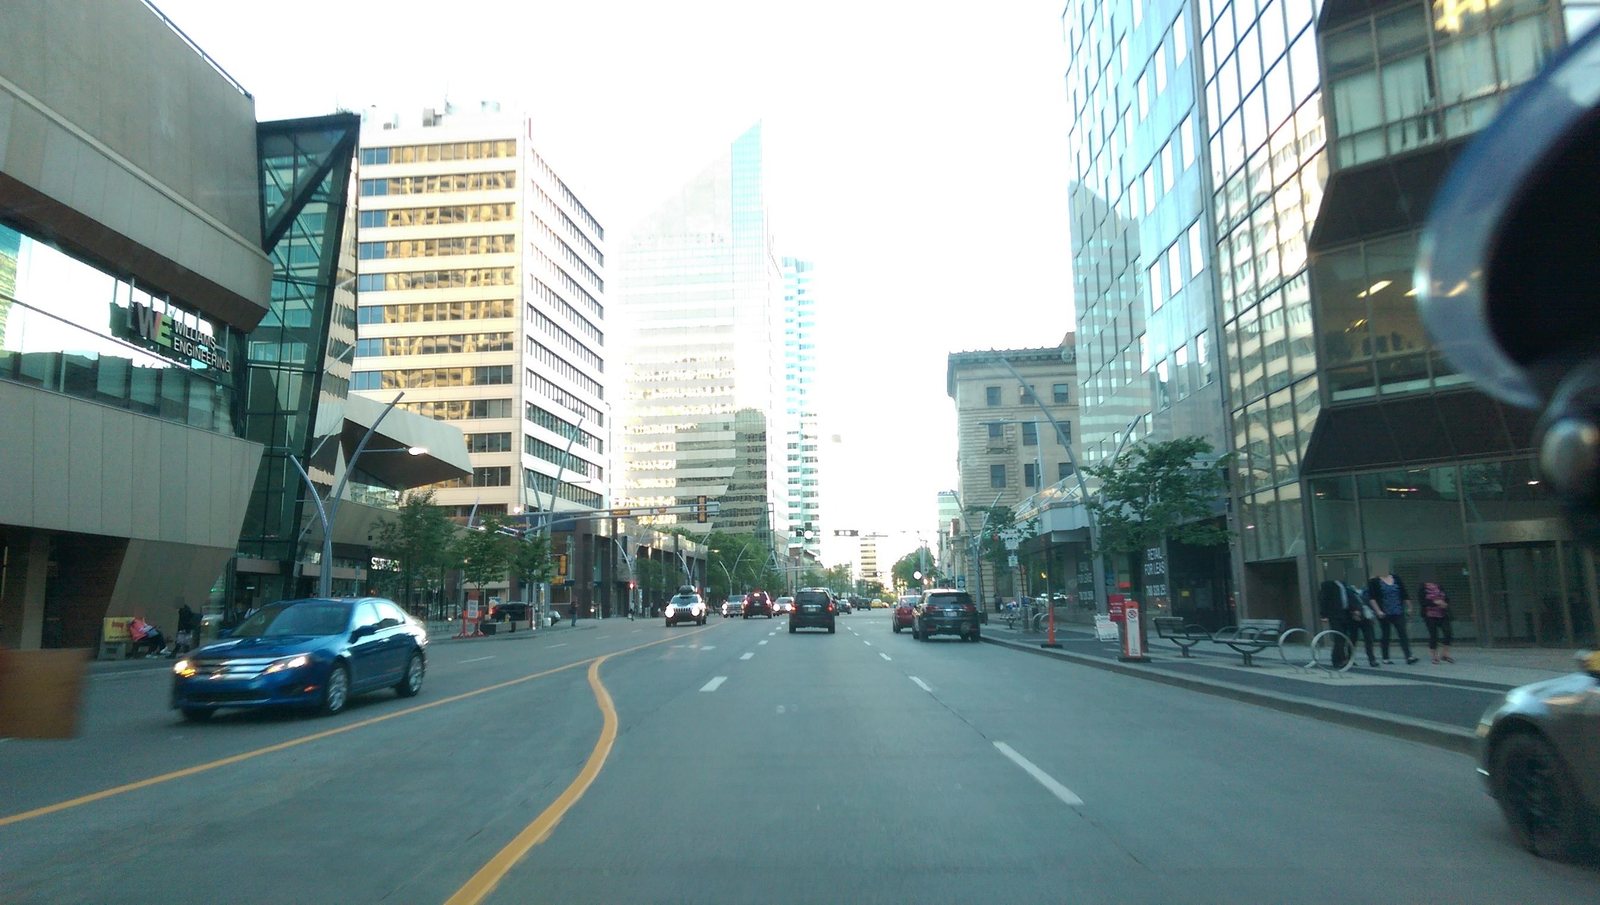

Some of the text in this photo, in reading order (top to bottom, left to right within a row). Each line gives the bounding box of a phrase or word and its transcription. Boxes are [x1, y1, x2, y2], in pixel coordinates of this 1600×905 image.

[174, 319, 217, 351] WILLIAMS
[174, 337, 231, 373] ENGINEERING
[1154, 561, 1165, 575] LEAS
